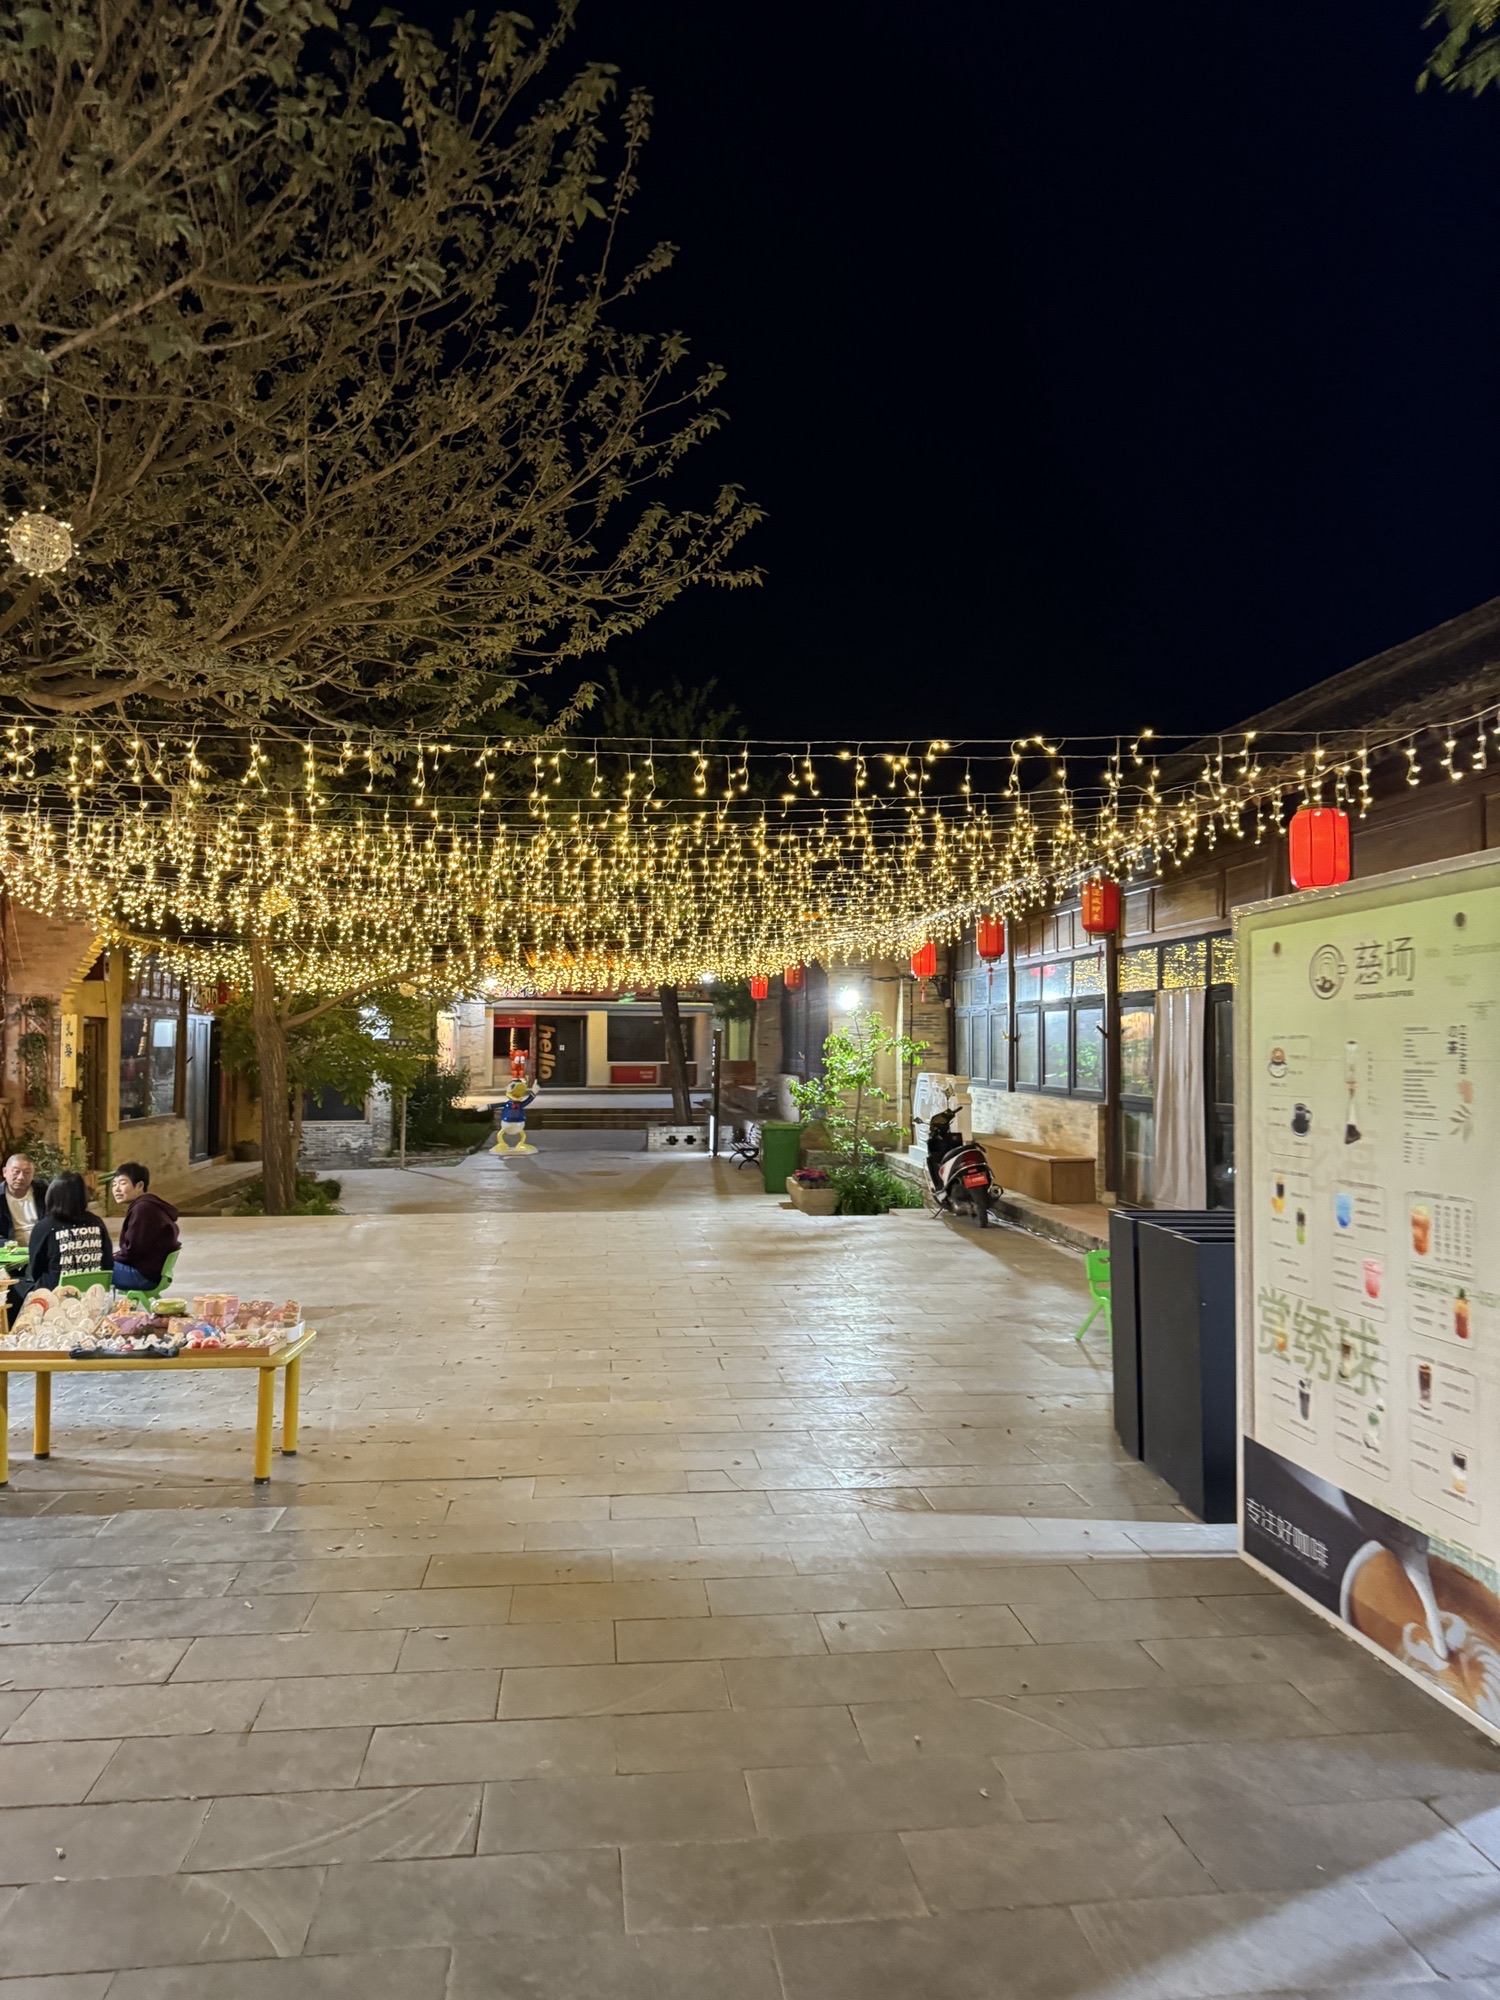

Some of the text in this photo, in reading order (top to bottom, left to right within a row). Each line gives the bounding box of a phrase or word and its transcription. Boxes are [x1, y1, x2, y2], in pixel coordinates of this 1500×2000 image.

[539, 1024, 556, 1080] hello
[55, 1226, 100, 1240] IN YOUR
[59, 1253, 103, 1265] IN YOUR
[1245, 1498, 1330, 1568] 专注好咖啡
